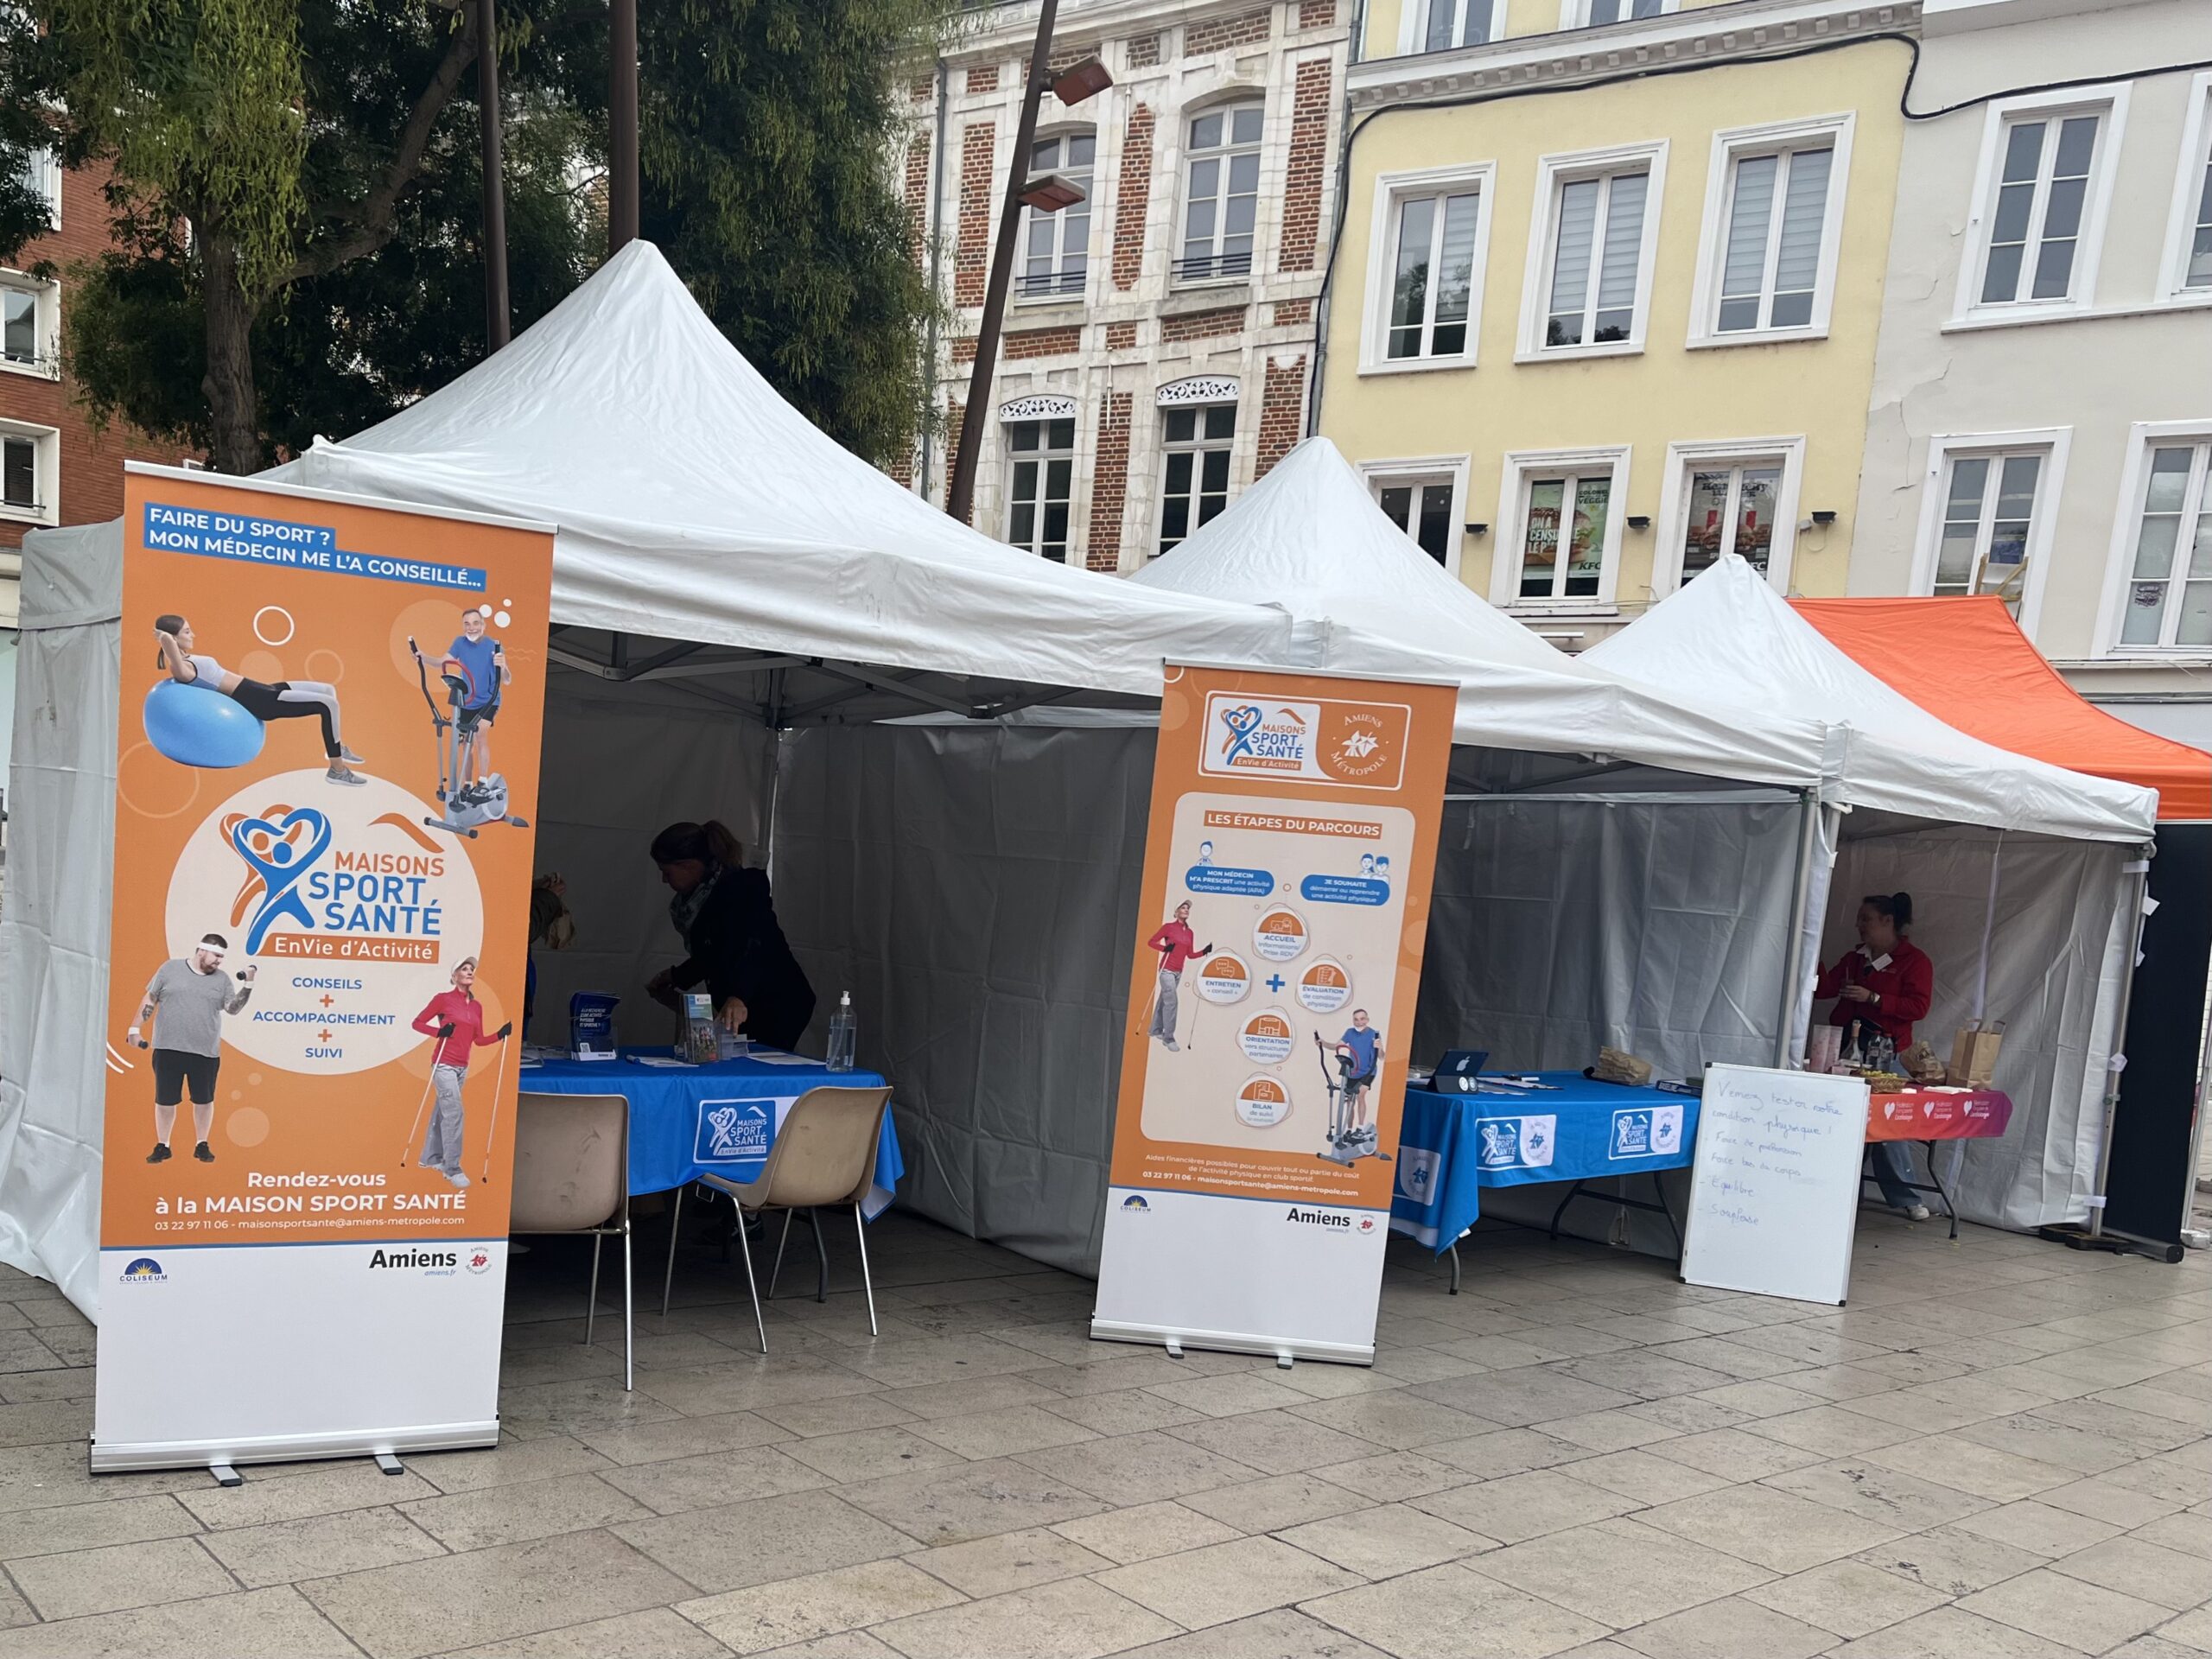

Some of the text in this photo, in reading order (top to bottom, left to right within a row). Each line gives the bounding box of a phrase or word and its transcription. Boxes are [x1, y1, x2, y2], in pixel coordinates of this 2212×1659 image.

[149, 507, 331, 546] FAIRE DU SPORT ?
[149, 529, 482, 588] MON MÉDECIN ME L'A CONSEILLÉ...
[1578, 562, 1602, 570] KFC
[1344, 713, 1383, 728] AMIENS
[1262, 723, 1306, 735] MAISONS
[1250, 733, 1299, 747] SPORT
[1256, 744, 1305, 760] SANTÉ
[1236, 758, 1300, 770] EnVie d'Activité
[1331, 751, 1388, 777] MÉTROPOLE
[1207, 813, 1381, 836] LES ÉTAPES DU PARCOURS
[334, 850, 445, 877] MAISONS
[308, 871, 427, 906] SPORT
[324, 899, 442, 936] SANTÉ
[1263, 934, 1296, 944] ACCUEIL
[275, 936, 433, 960] EnVie d'Activité
[292, 976, 363, 990] CONSEILS
[1205, 980, 1242, 988] ENTRETIEN
[1302, 985, 1344, 995] ÉVALUATION
[252, 1010, 396, 1026] ACCOMPAGNEMENT
[1245, 1036, 1290, 1046] ORIENTATION
[305, 1047, 342, 1058] SUIVI
[1718, 1081, 1764, 1110] Venez
[1771, 1092, 1808, 1109] tester
[736, 1117, 767, 1127] MAISONS
[1712, 1109, 1757, 1123] condition
[1763, 1116, 1821, 1140] physique
[730, 1125, 762, 1137] SPORT
[734, 1131, 767, 1146] SANTÉ
[1146, 1154, 1166, 1162] Aides
[1166, 1154, 1205, 1166] financières
[1205, 1159, 1239, 1168] possibles
[1257, 1164, 1282, 1173] couvrir
[1309, 1168, 1332, 1178] partie
[1344, 1172, 1360, 1180] coût
[1198, 1166, 1229, 1175] l'activité
[1229, 1169, 1262, 1179] physique
[1273, 1173, 1289, 1181] club
[247, 1171, 386, 1188] Rendez-vous
[1197, 1176, 1359, 1197] maisonsportsante@amiens-metropole.com
[155, 1190, 467, 1214] à la MAISON SPORT SANTÉ
[155, 1221, 168, 1230] 03
[171, 1221, 184, 1230] 22
[187, 1220, 201, 1230] 97
[203, 1220, 212, 1230] 11
[213, 1220, 229, 1229] 06
[238, 1217, 465, 1230] maisonsportsante@amiens-metropole.com
[1287, 1207, 1351, 1227] Amiens
[369, 1248, 457, 1269] Amiens
[119, 1274, 168, 1282] COLISEUM
[423, 1268, 456, 1277] amiens.fr
